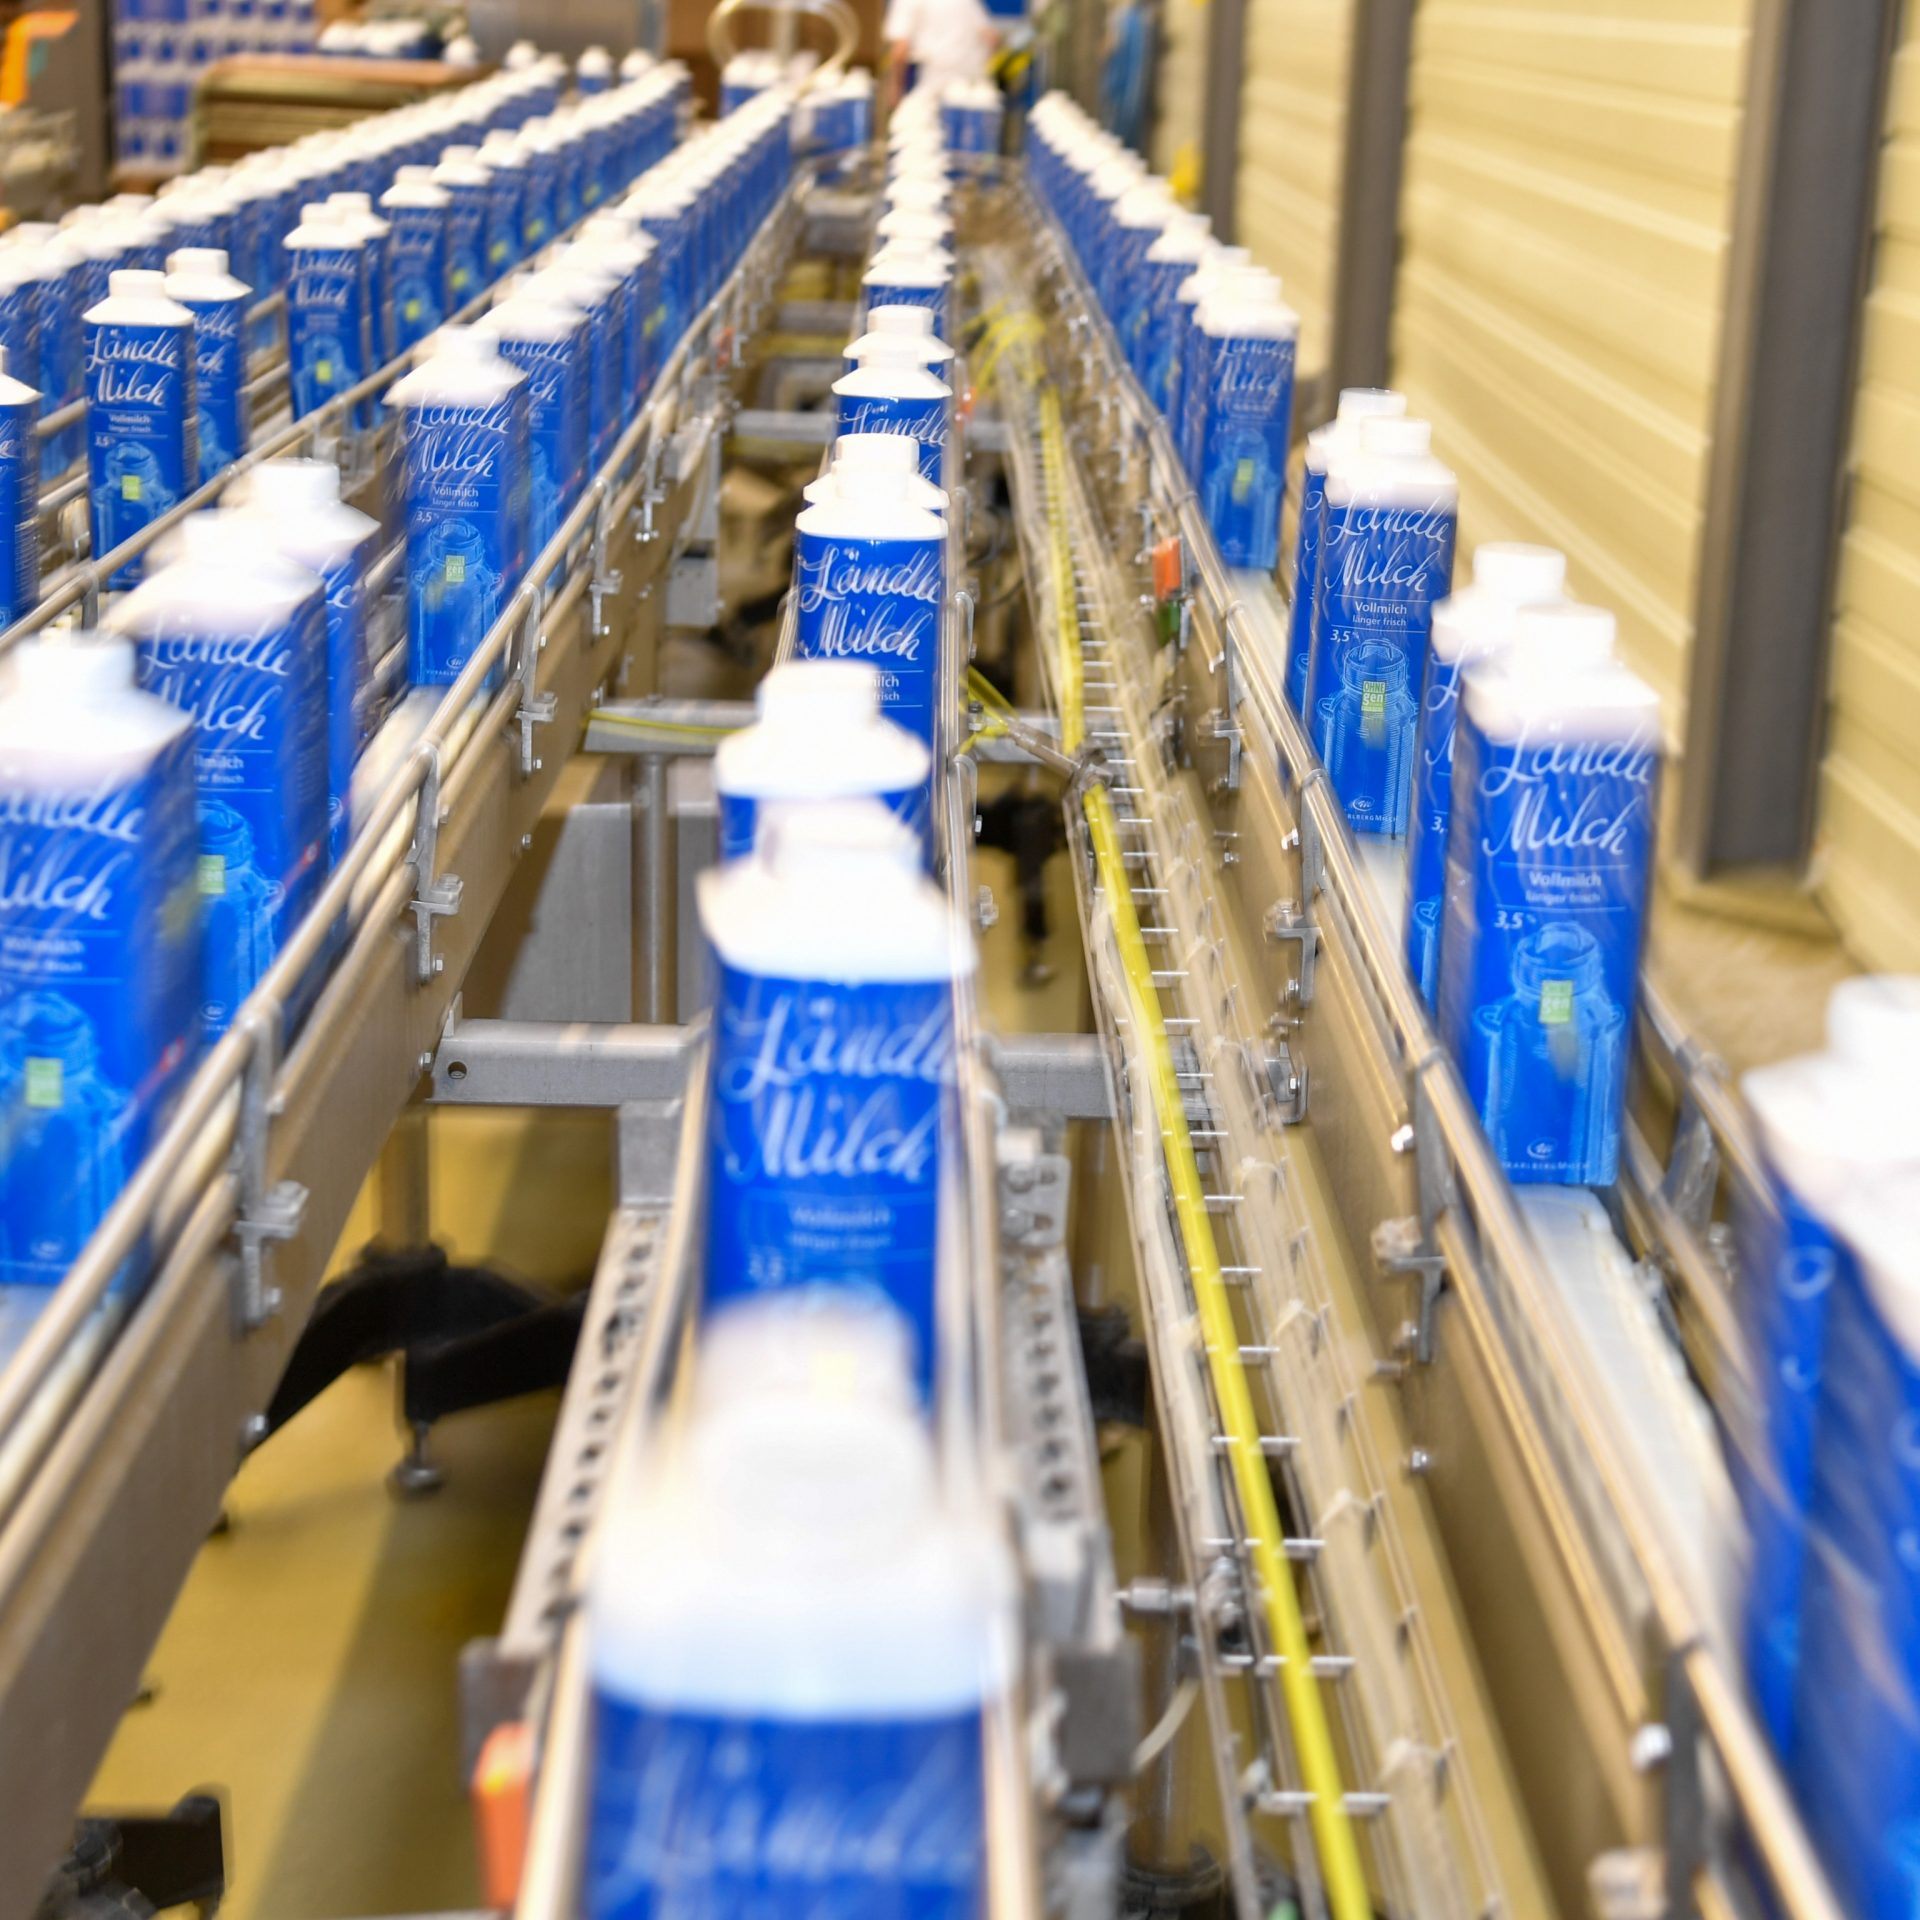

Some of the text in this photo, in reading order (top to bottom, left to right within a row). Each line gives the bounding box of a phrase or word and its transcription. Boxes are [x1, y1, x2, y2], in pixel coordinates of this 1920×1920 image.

[89, 363, 174, 407] Milch
[409, 431, 505, 478] Milch
[434, 486, 479, 498] Vollmilch
[1325, 489, 1450, 545] Ländle
[1325, 537, 1441, 592] Milch
[1355, 601, 1408, 615] Vollmilch
[1383, 616, 1407, 626] frisch
[1330, 629, 1351, 643] 3,5
[1363, 692, 1384, 706] gen
[1482, 782, 1645, 857] Milch
[1529, 871, 1602, 887] Vollmilch
[1493, 910, 1524, 930] 3,5
